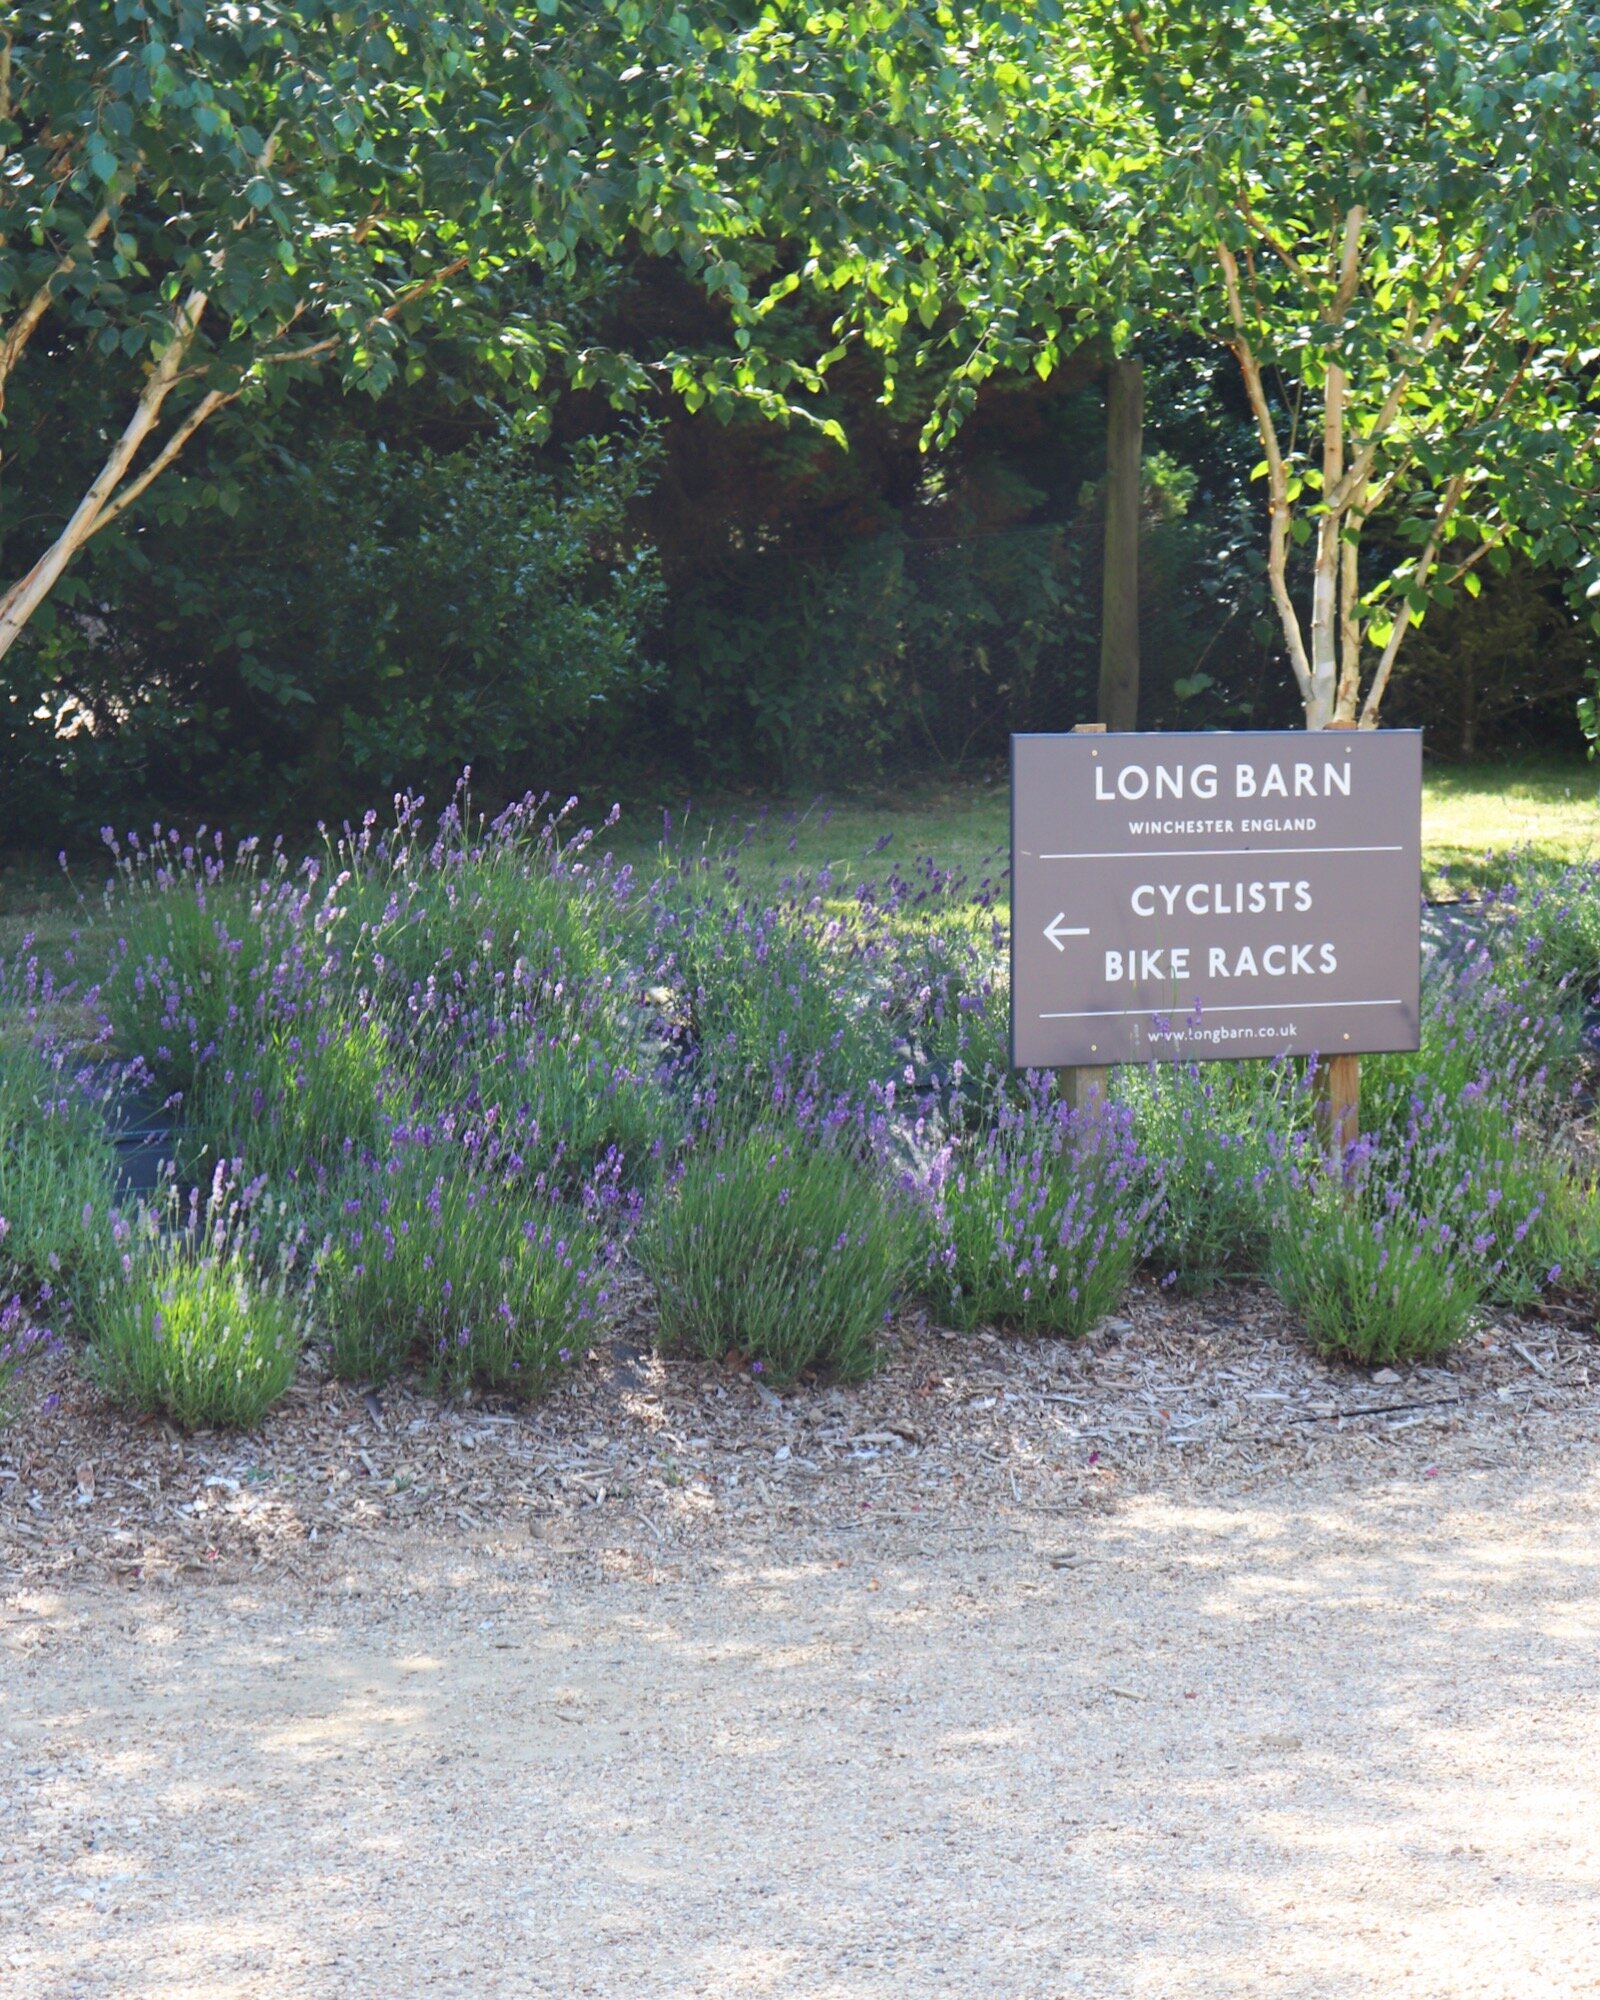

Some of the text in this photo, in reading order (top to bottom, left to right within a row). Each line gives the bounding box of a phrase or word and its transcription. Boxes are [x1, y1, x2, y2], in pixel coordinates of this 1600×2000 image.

[1095, 762, 1351, 801] LONG BARN
[1128, 818, 1317, 835] WINCHESTER ENGLAND
[1130, 880, 1313, 917] CYCLISTS
[1105, 943, 1338, 982] BIKE RACKS
